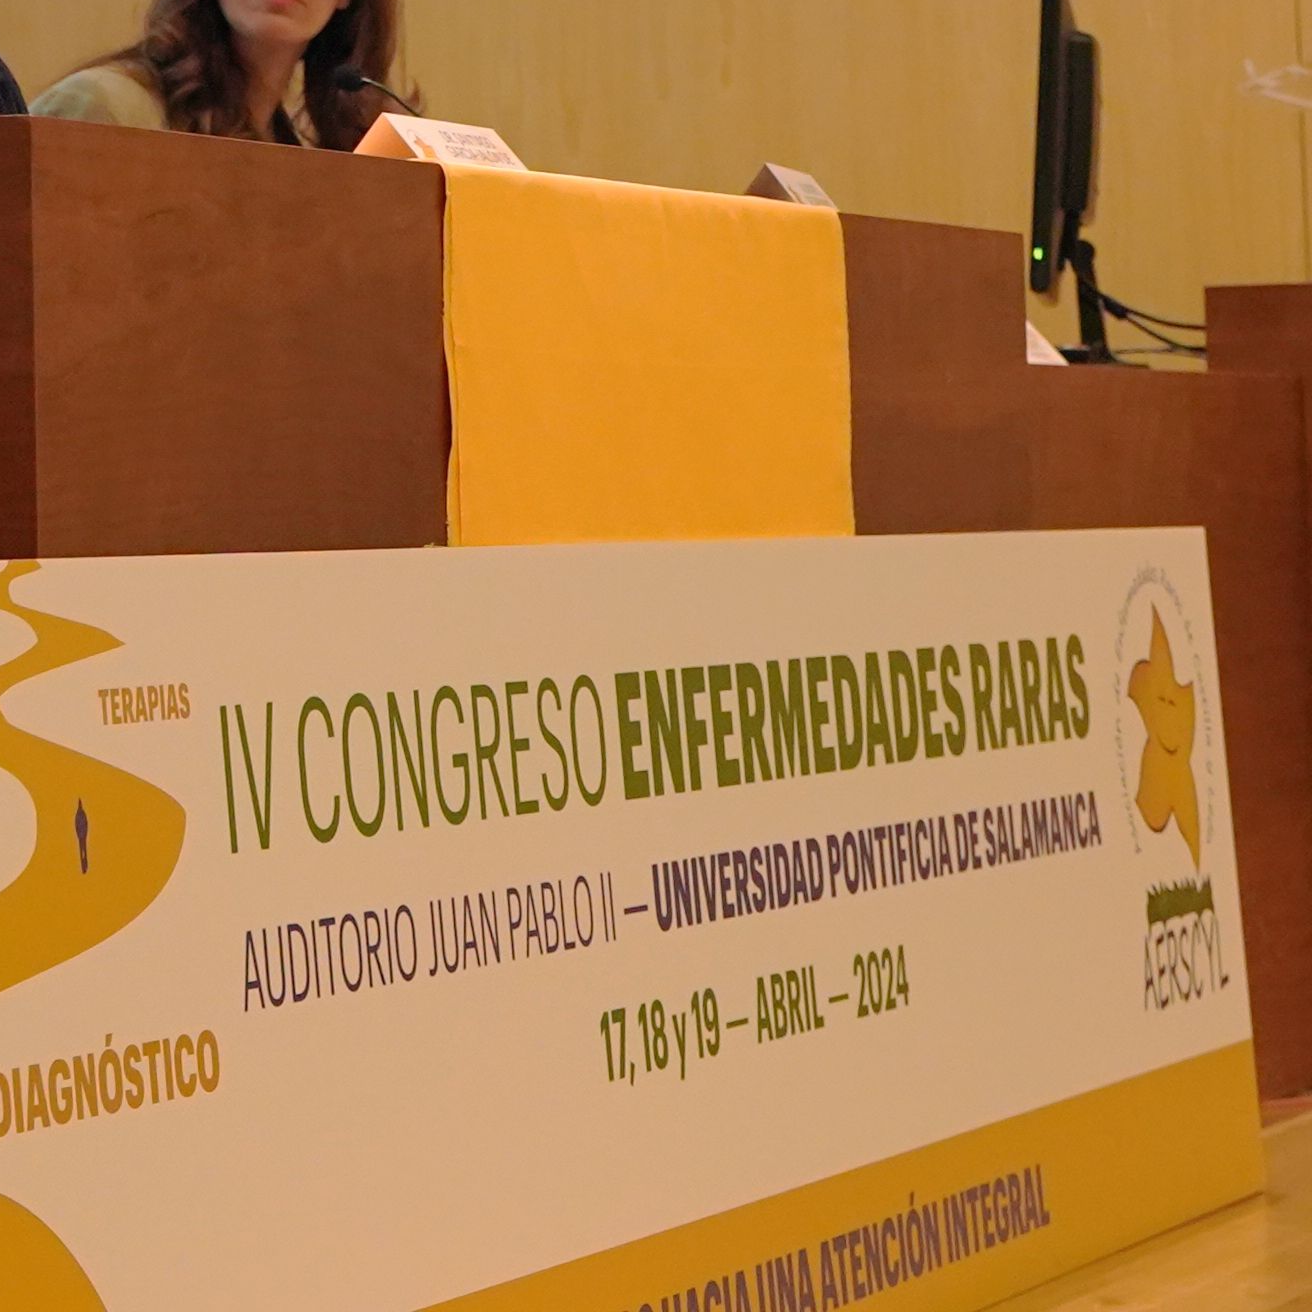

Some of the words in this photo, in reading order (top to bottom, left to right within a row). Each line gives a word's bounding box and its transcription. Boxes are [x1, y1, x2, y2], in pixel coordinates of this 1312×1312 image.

[98, 682, 191, 726] TERAPIAS
[219, 702, 274, 854] IV
[298, 675, 607, 843] CONGRESO
[614, 643, 968, 801] ENFERMEDADES
[968, 634, 1091, 752] RARAS
[244, 905, 418, 1012] AUDITORIO
[429, 890, 502, 977] JUAN
[507, 875, 595, 961] PABLO
[599, 871, 617, 943] II
[652, 838, 824, 931] UNIVERSIDAD
[827, 815, 955, 899] PONTIFICIA
[955, 809, 982, 873] DE
[983, 791, 1102, 866] SALAMANCA
[1143, 914, 1230, 1011] AERSCYL
[600, 1008, 635, 1085] 17,
[637, 999, 669, 1072] 18
[672, 1011, 688, 1081] y
[690, 987, 721, 1059] 19
[756, 964, 824, 1043] ABRIL
[852, 944, 910, 1018] 2024
[755, 1248, 818, 1312] UNA
[819, 1192, 943, 1311] ATENCIÓN
[942, 1164, 1050, 1264] INTEGRAL
